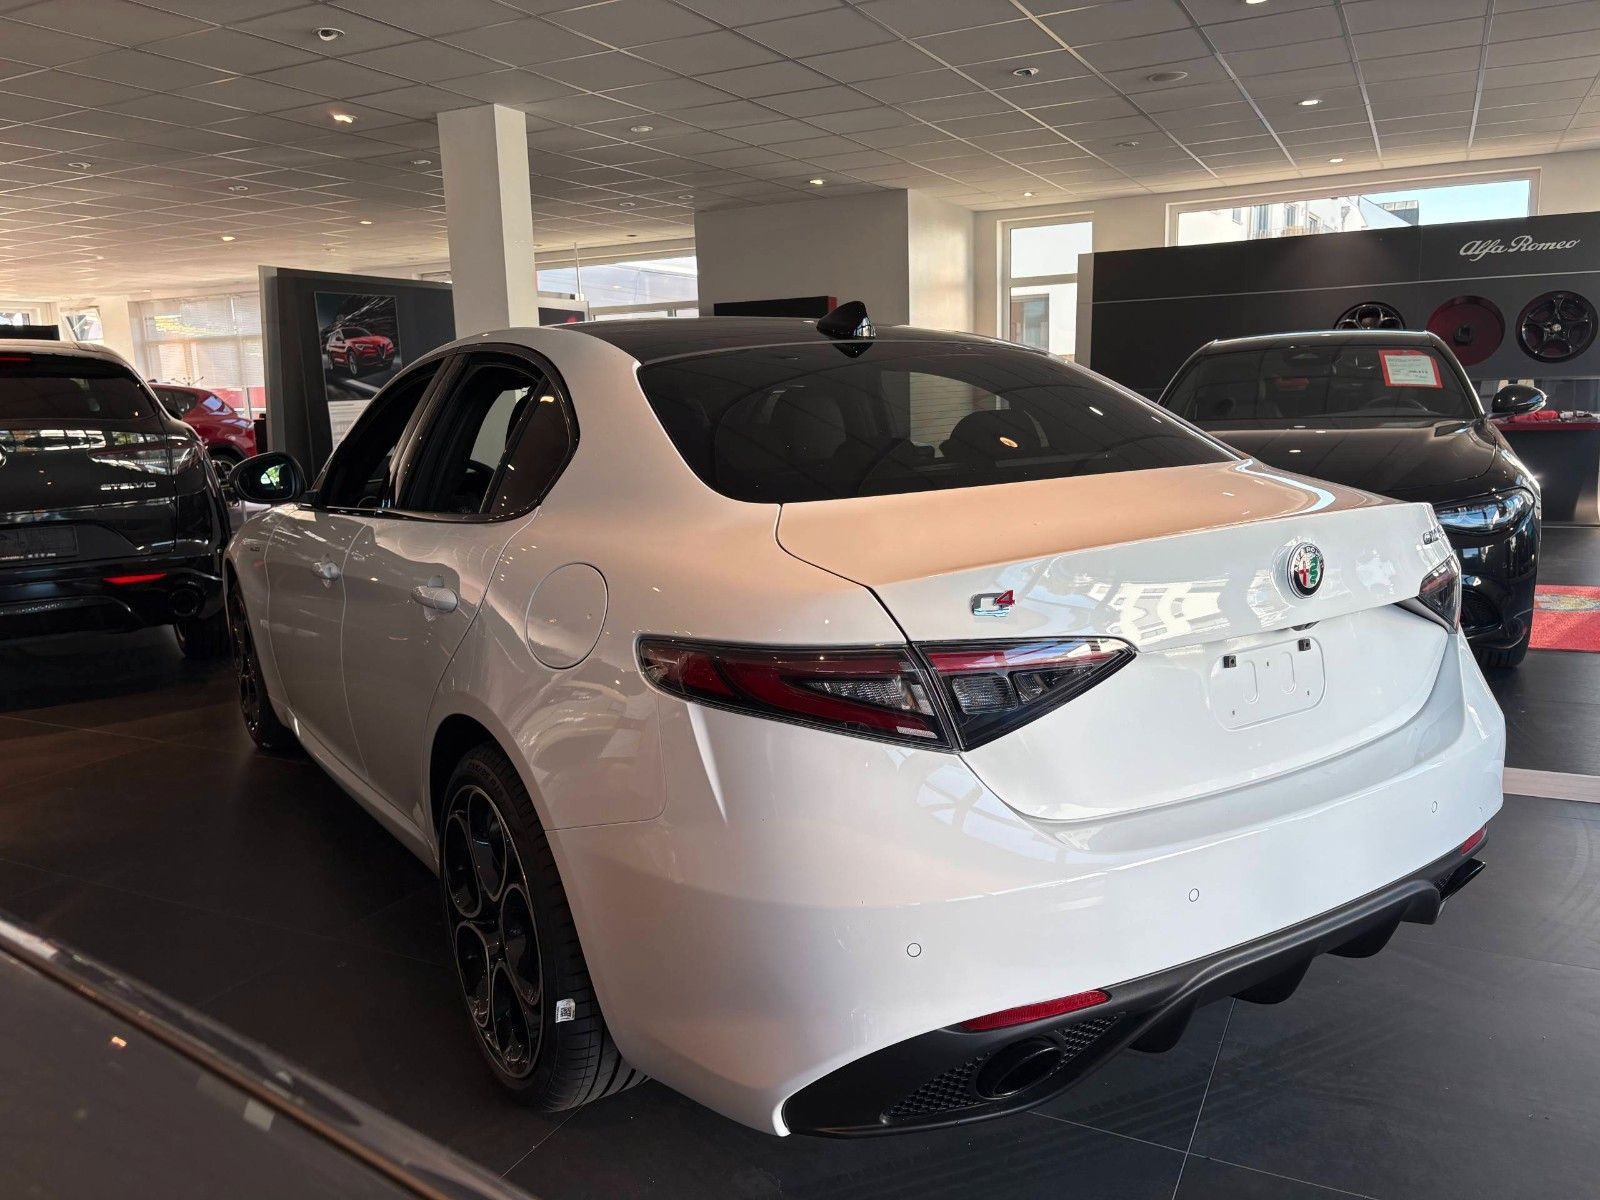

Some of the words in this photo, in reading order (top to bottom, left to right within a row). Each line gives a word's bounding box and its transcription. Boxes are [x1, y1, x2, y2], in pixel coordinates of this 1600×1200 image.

[1460, 239, 1508, 262] Alfa
[1507, 235, 1580, 252] Romeo
[100, 481, 157, 491] STELVIO
